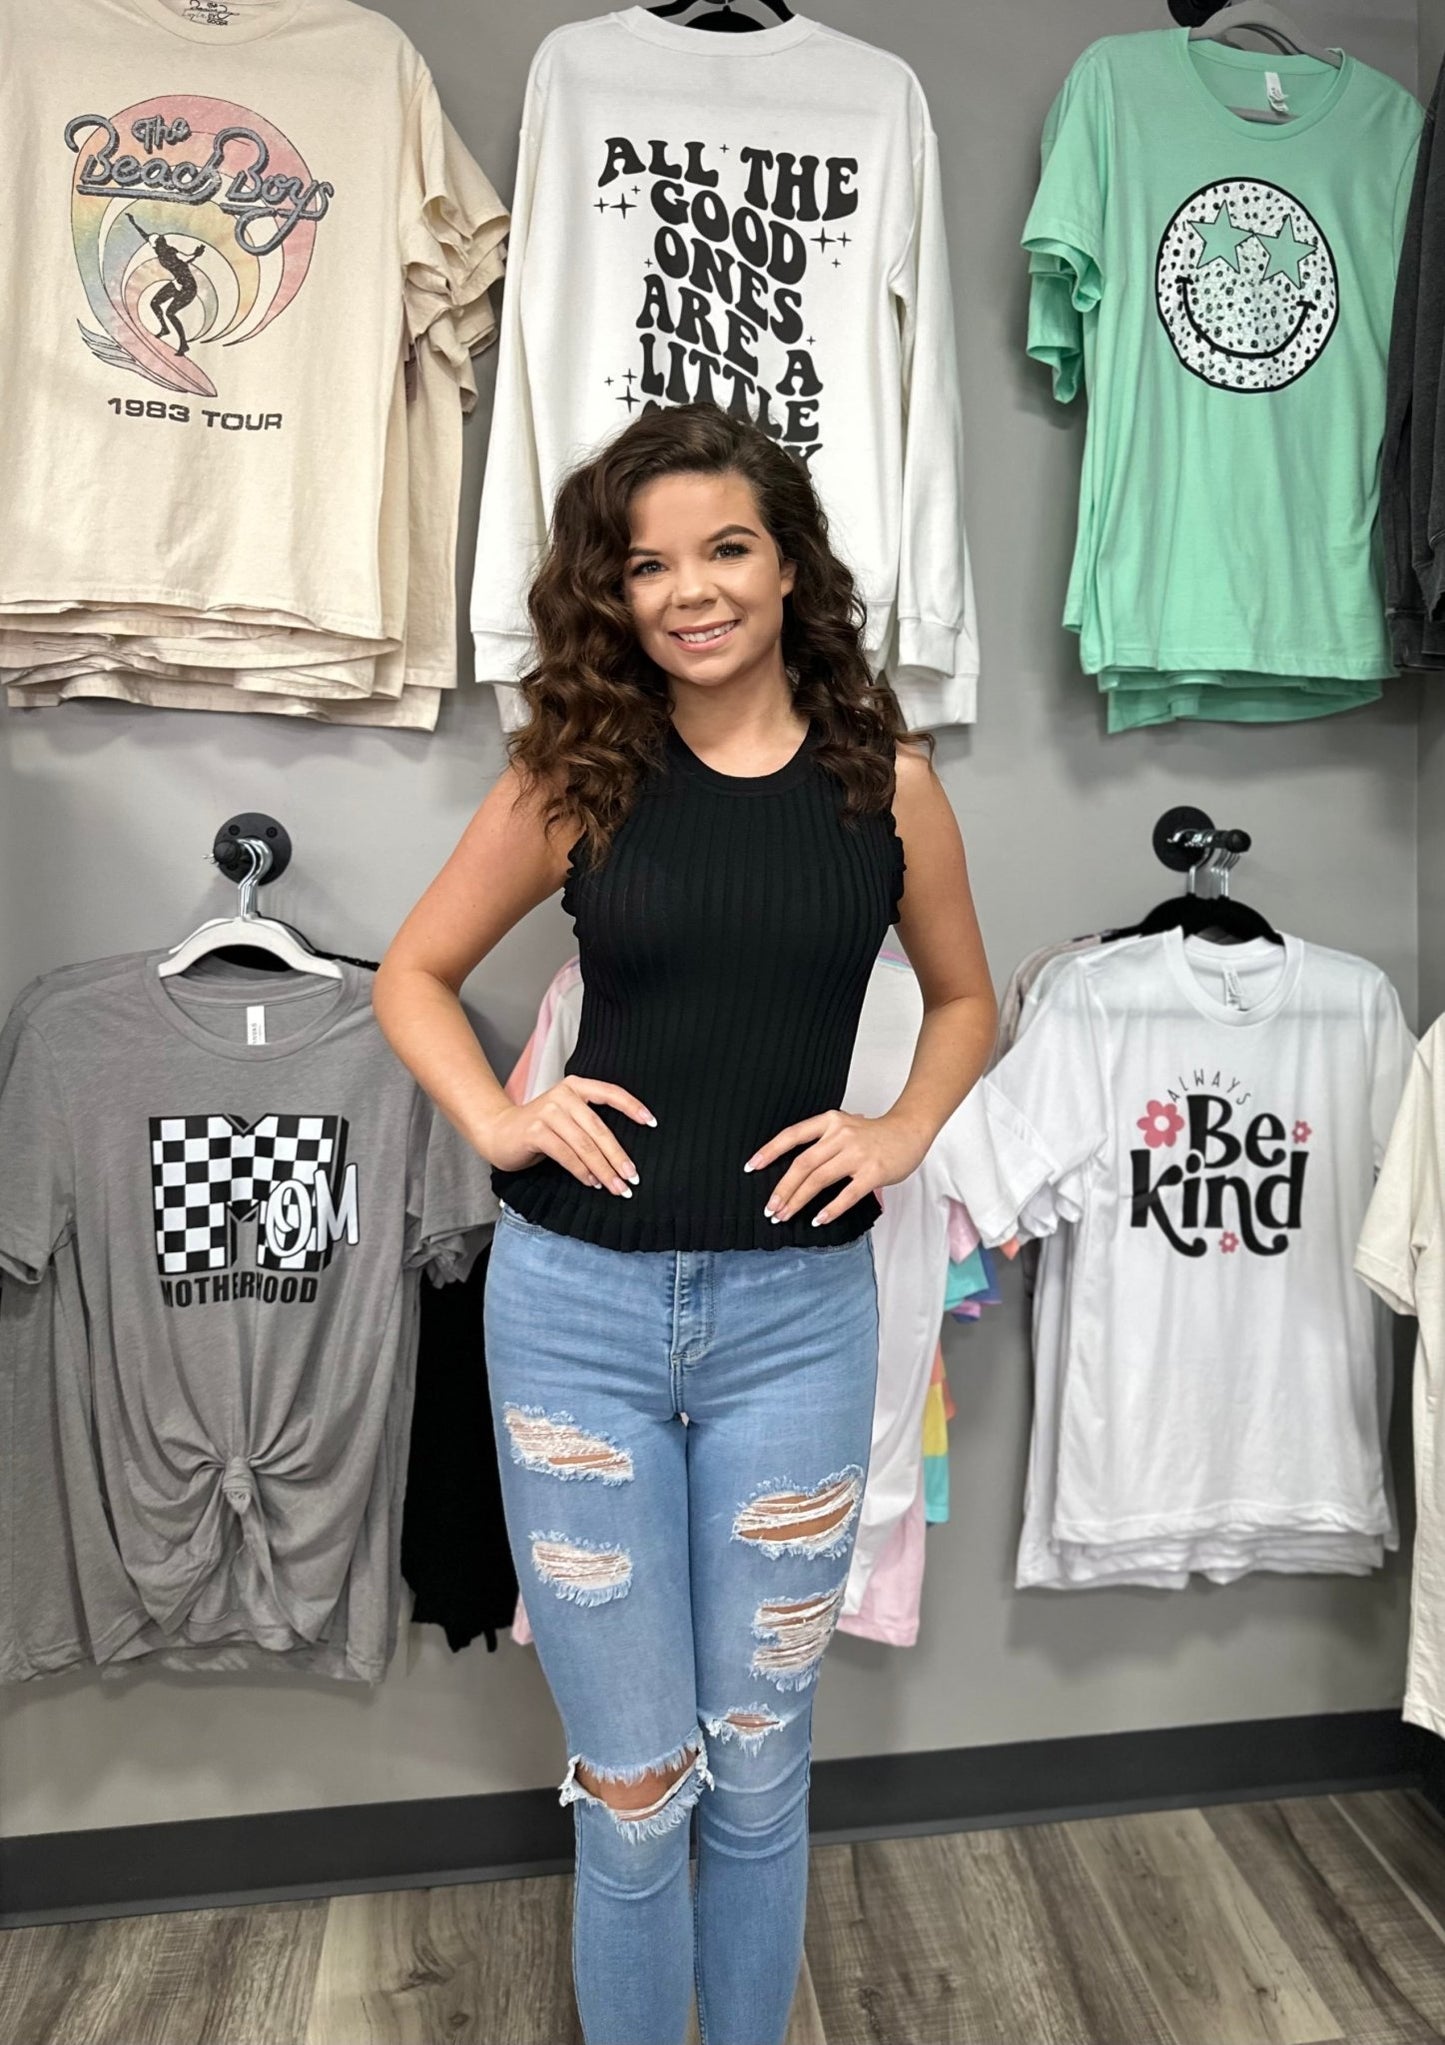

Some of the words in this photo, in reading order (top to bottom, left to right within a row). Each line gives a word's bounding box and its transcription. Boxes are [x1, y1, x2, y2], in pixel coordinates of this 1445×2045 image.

[64, 114, 224, 206] Beach
[214, 127, 334, 256] Boys
[131, 115, 192, 154] The
[598, 137, 719, 188] ALL
[740, 146, 858, 221] THE
[650, 179, 807, 285] GOOD
[654, 226, 804, 344] ONES
[636, 274, 759, 377] ARE
[775, 349, 824, 397] A
[640, 332, 819, 442] LITTLE
[107, 398, 190, 423] 1983
[201, 409, 282, 431] TOUR
[1167, 1068, 1251, 1105] ALWAYS
[1186, 1094, 1287, 1169] Be
[1130, 1148, 1309, 1258] kind
